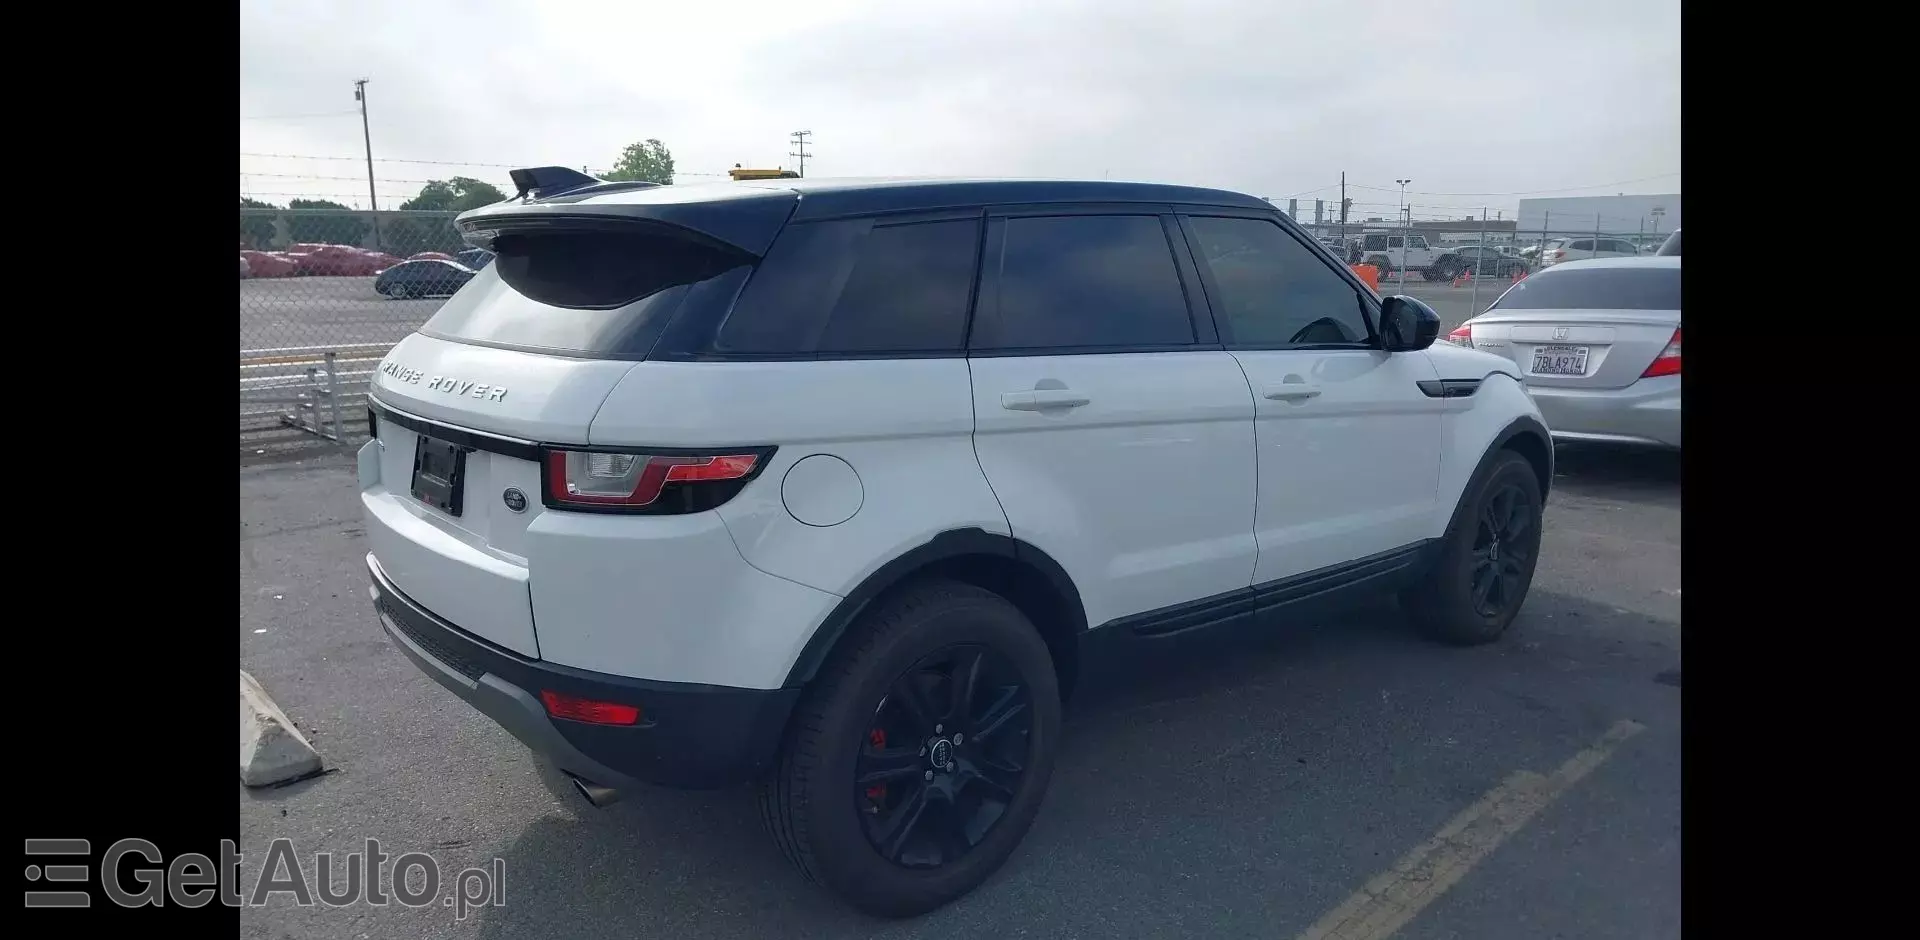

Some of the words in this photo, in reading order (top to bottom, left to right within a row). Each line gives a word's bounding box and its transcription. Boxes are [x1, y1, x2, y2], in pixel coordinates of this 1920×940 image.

[1535, 356, 1581, 369] 7BLA974
[383, 362, 424, 385] RANGE
[428, 375, 507, 403] ROVER
